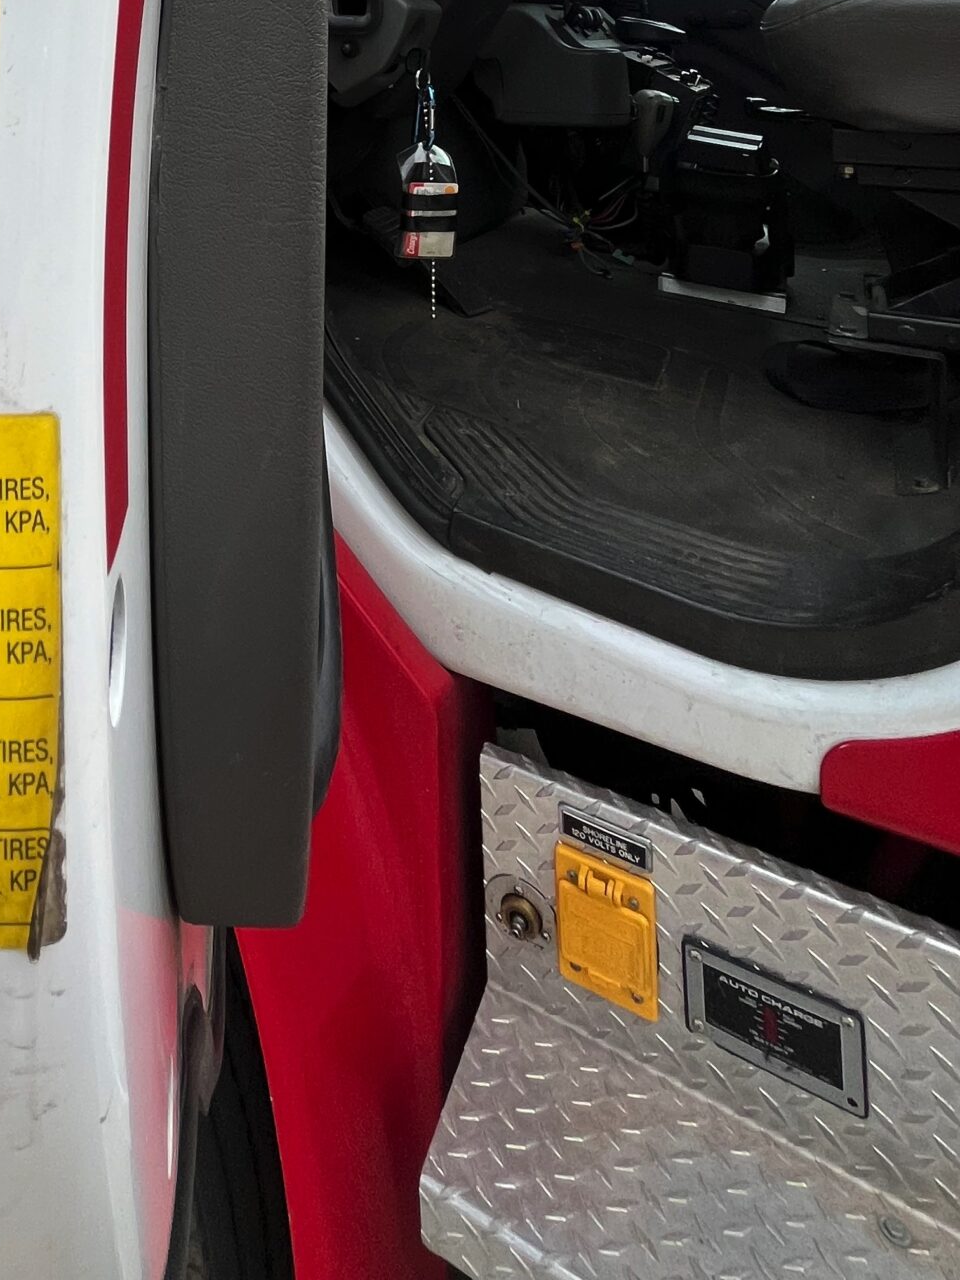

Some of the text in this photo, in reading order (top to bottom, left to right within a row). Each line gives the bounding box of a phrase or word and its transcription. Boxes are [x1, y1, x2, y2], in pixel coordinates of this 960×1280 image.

[5, 510, 50, 535] KPA,
[7, 642, 51, 667] KPA,
[572, 828, 640, 863] 120 VOLTS ONLY
[583, 826, 627, 850] SHORELINE
[719, 976, 758, 998] AUTO
[762, 995, 823, 1028] CHARGE
